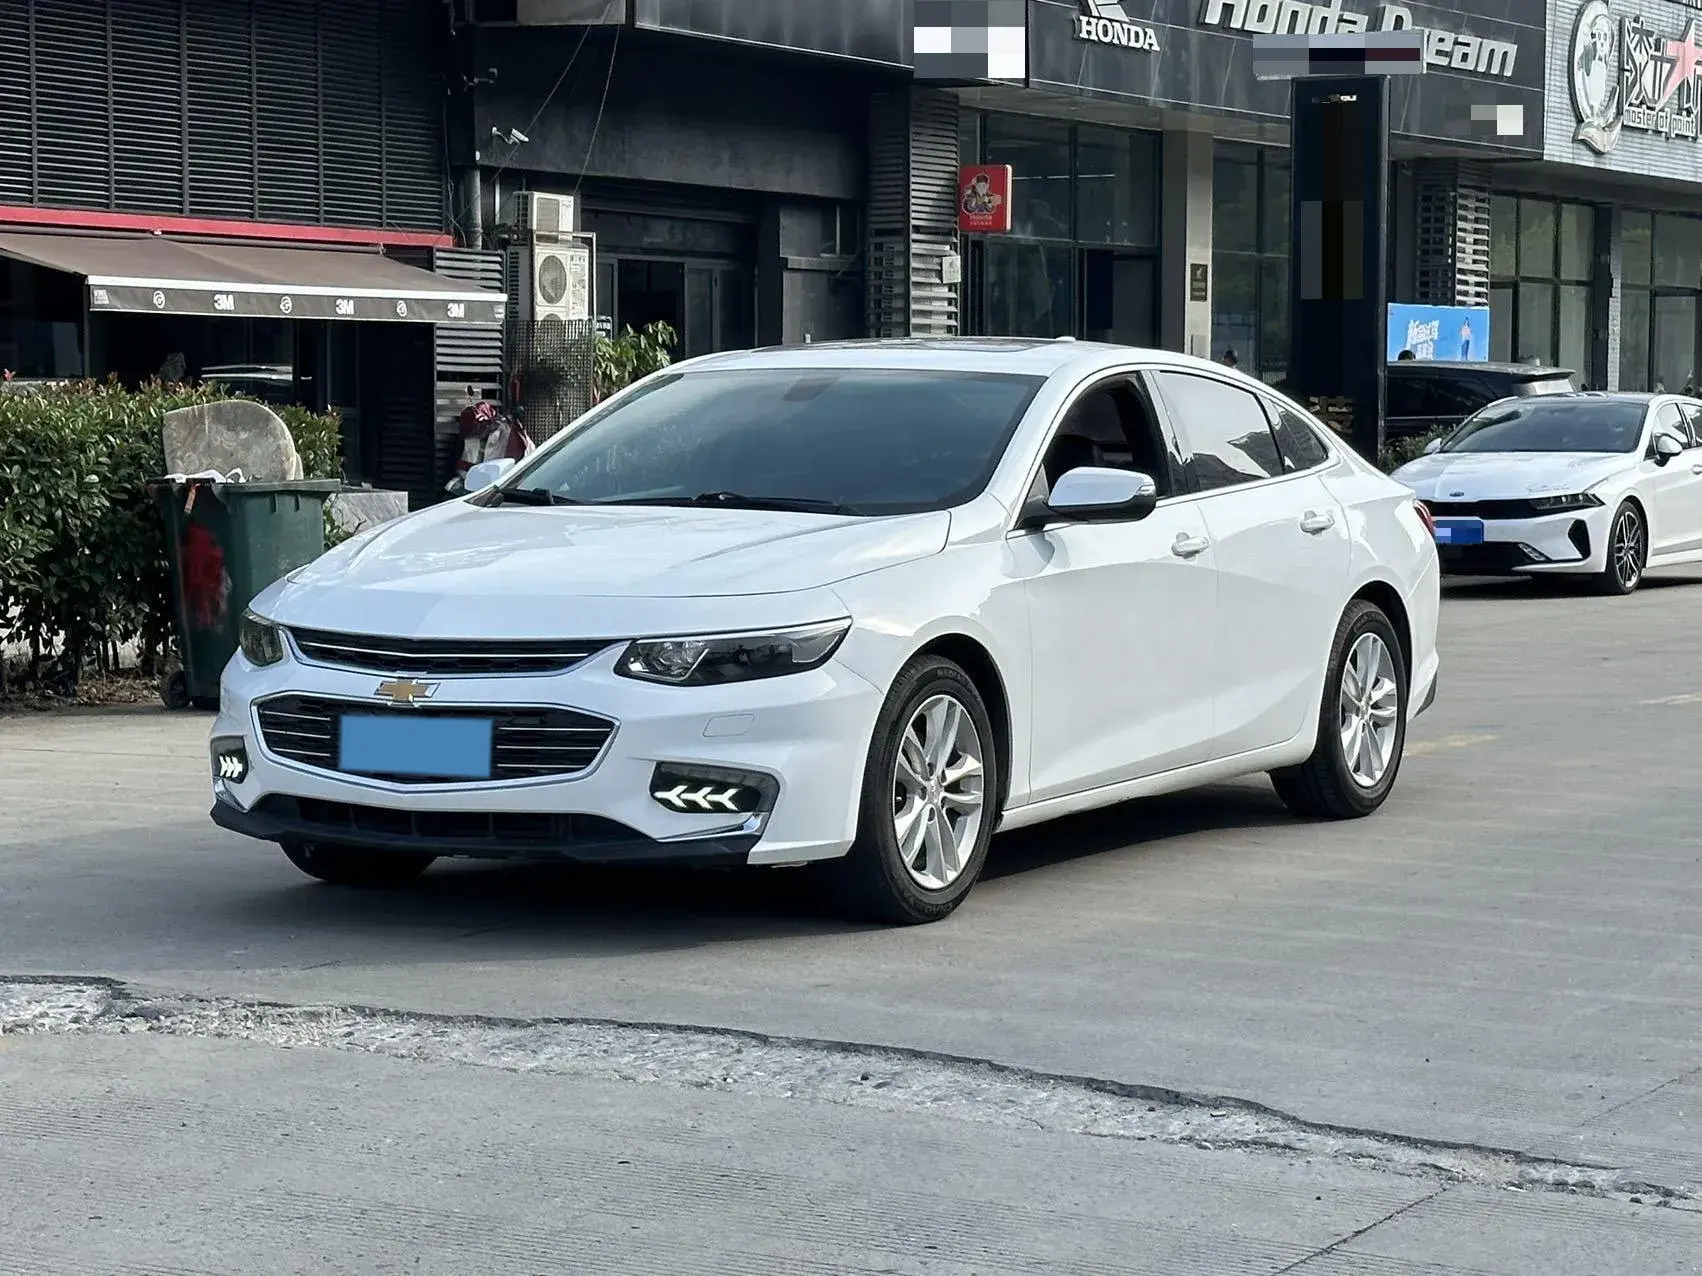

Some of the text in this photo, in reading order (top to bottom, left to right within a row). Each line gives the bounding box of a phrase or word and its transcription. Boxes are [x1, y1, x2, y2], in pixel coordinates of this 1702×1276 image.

[1079, 15, 1160, 52] HONDA
[1381, 4, 1518, 77] Deam
[213, 293, 465, 319] 3M 3M 3M
